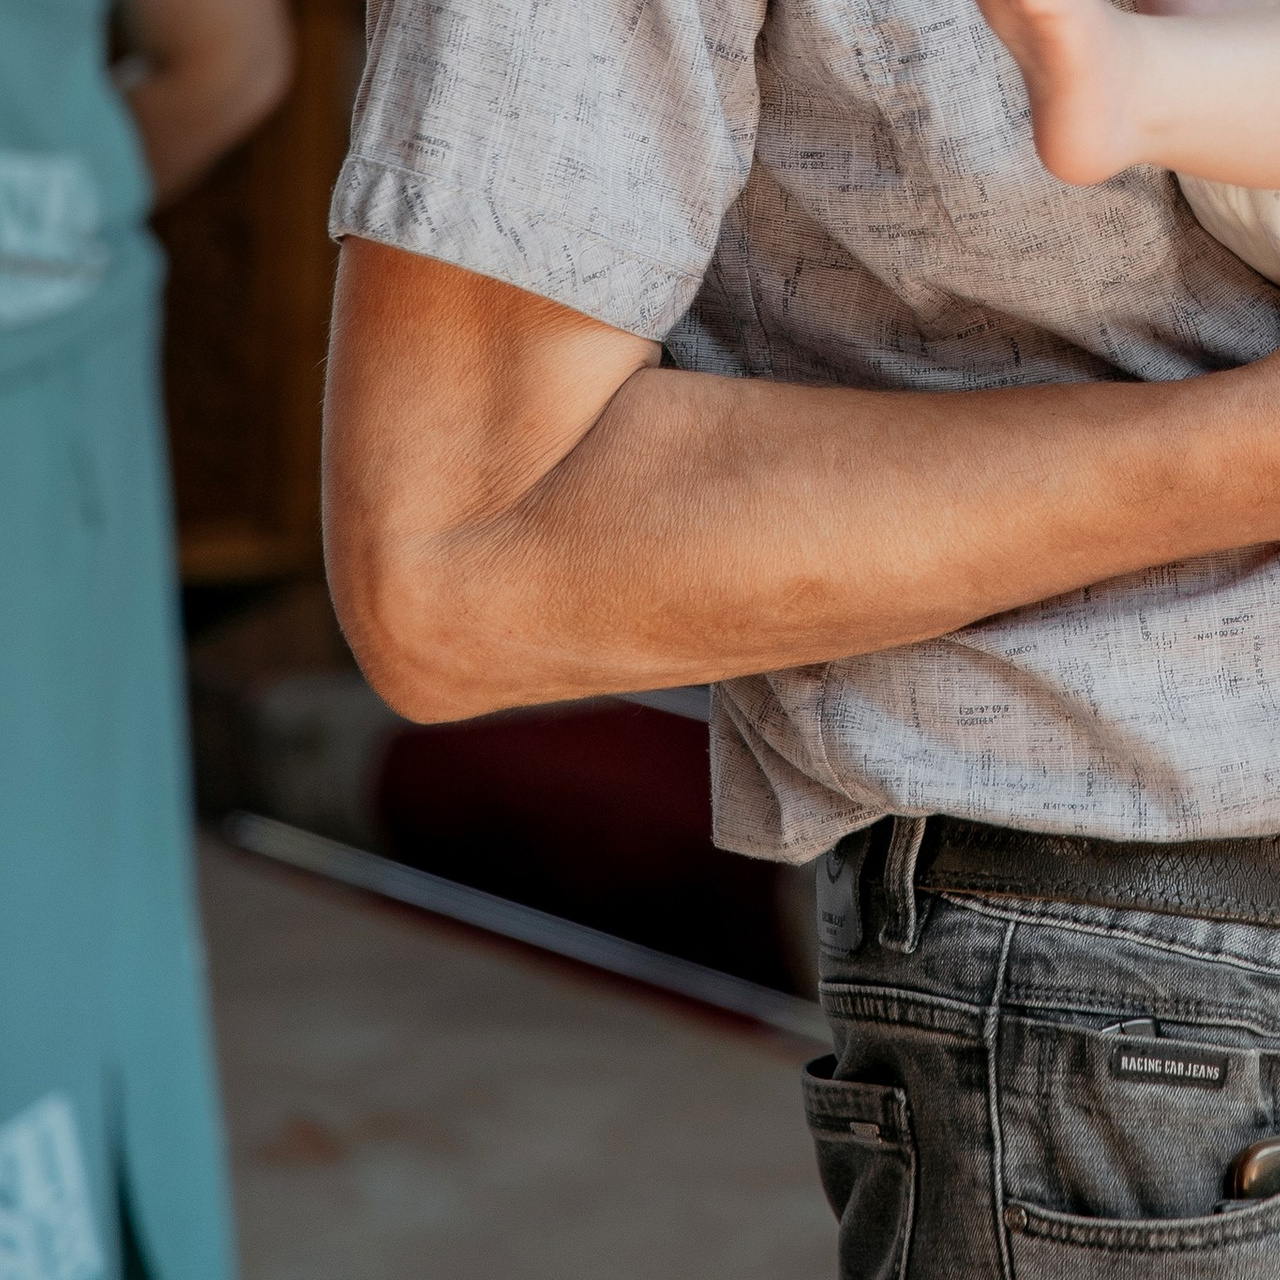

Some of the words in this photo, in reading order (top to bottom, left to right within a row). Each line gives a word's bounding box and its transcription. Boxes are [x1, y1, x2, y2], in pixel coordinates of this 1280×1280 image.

[1121, 1056, 1162, 1072] RACING
[1164, 1059, 1184, 1076] CAR
[1185, 1063, 1220, 1080] JEANS
